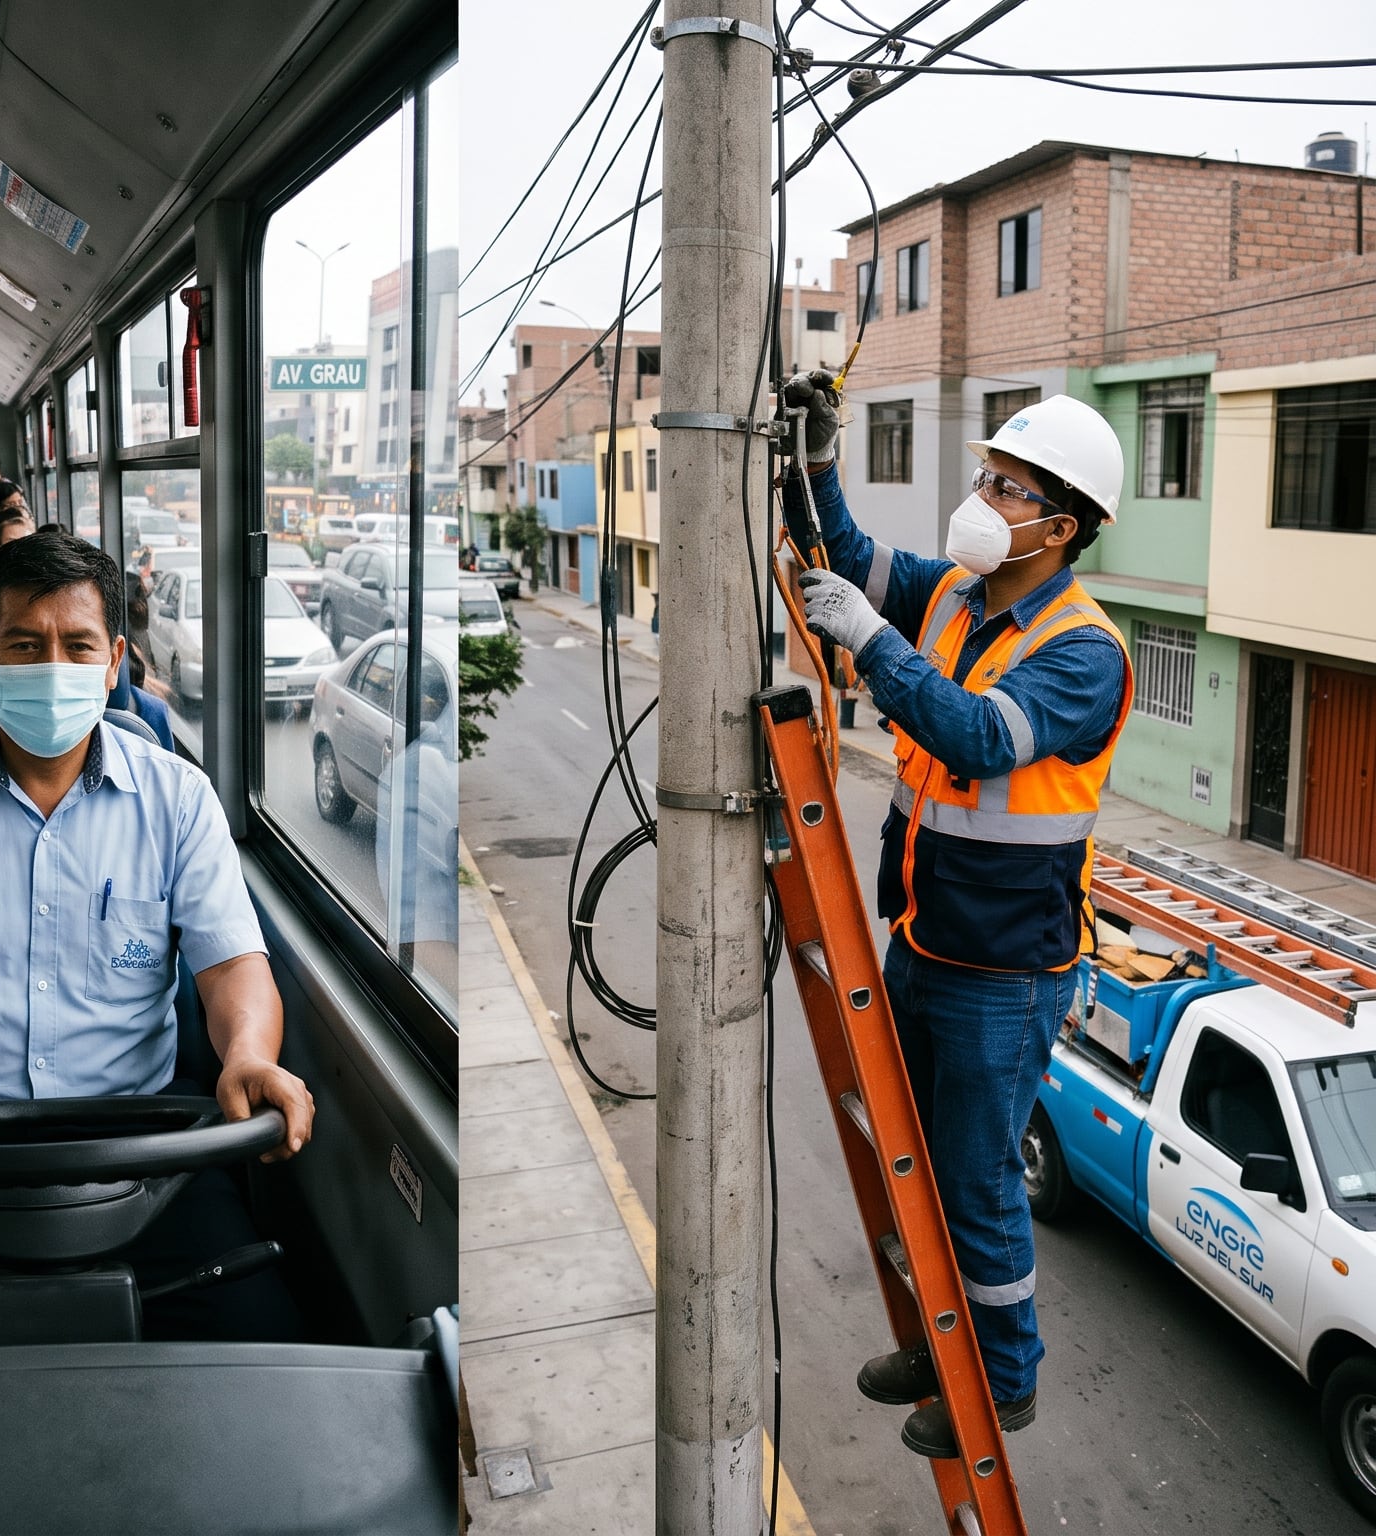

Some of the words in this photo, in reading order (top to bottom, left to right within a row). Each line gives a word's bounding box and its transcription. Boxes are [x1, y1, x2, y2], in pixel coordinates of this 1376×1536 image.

[277, 364, 304, 384] AV.
[310, 363, 361, 384] GRAU
[1176, 1216, 1204, 1250] LUZ
[1207, 1241, 1237, 1276] DEL
[1239, 1266, 1274, 1304] SUR
